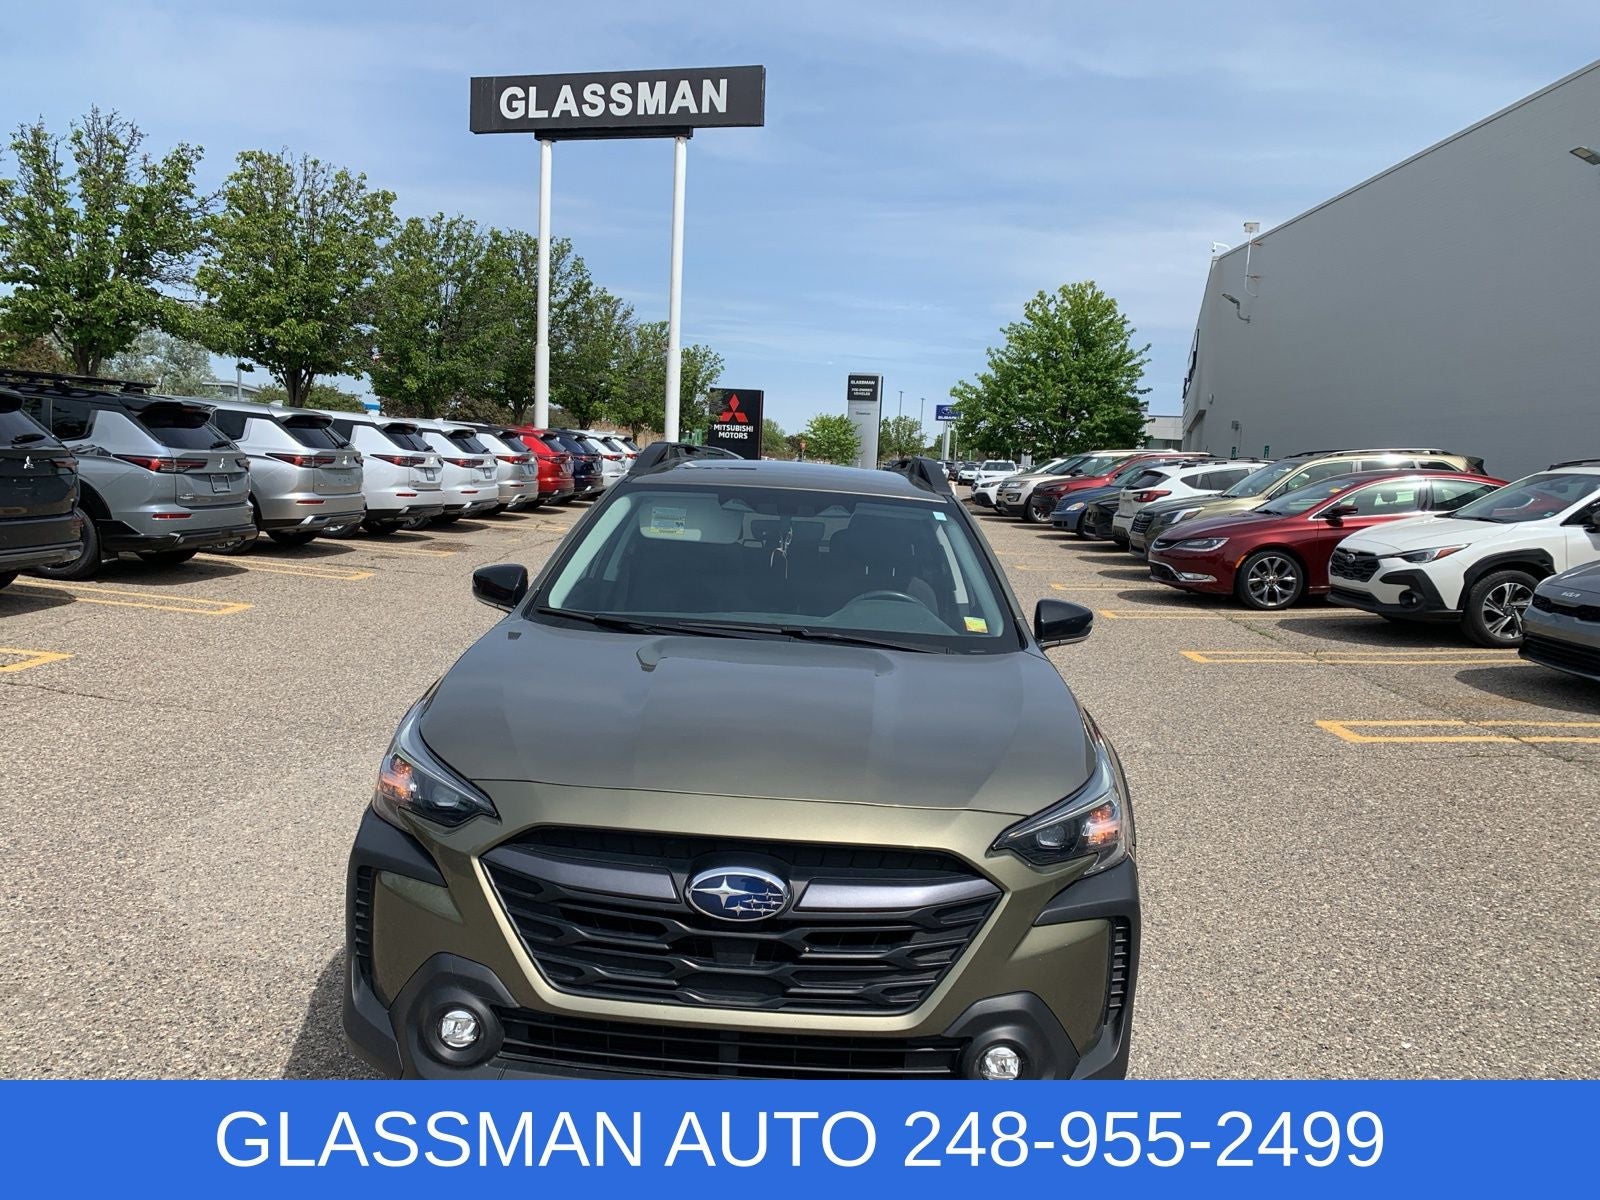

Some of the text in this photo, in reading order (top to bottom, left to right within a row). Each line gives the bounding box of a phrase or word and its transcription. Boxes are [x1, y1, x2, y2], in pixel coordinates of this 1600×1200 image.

[499, 78, 728, 120] GLASSMAN
[713, 424, 754, 432] MITSUBISHI
[718, 431, 748, 439] MOTORS
